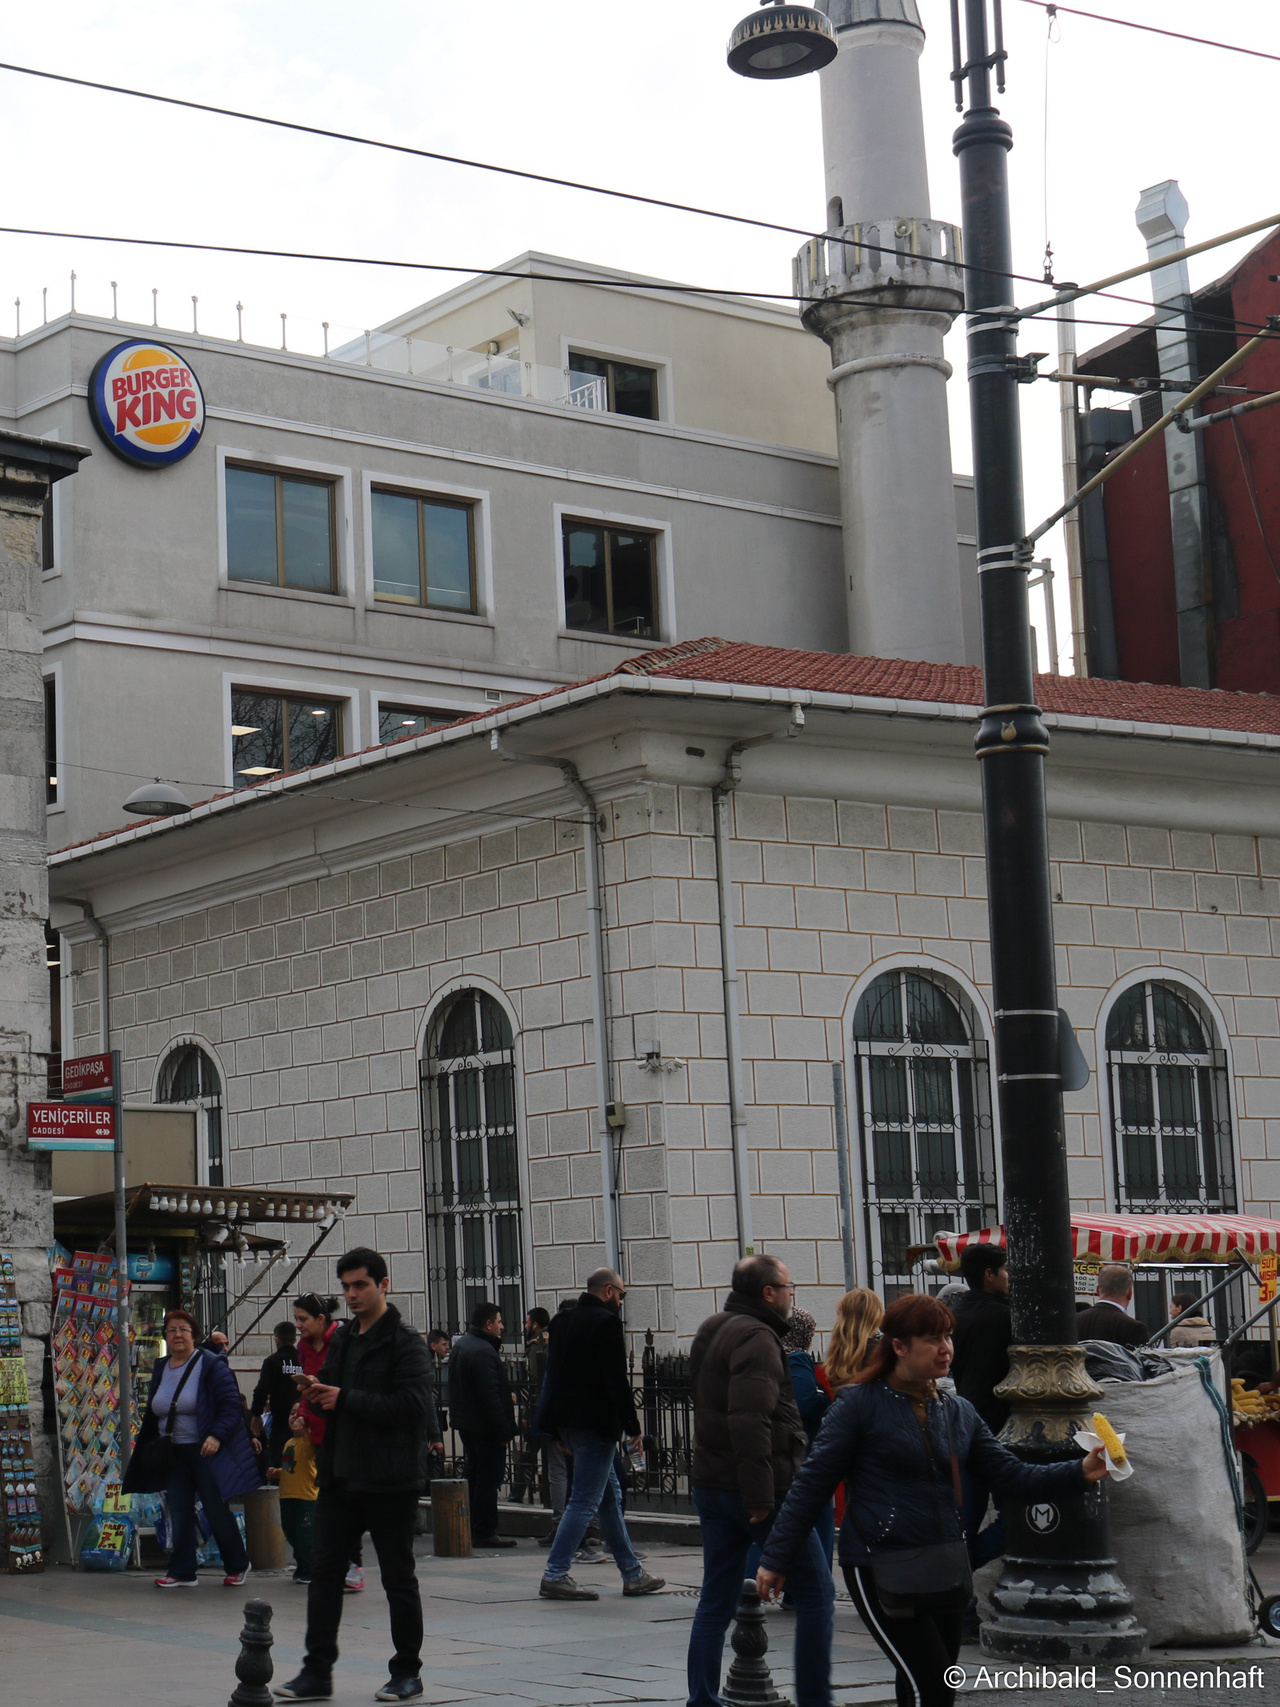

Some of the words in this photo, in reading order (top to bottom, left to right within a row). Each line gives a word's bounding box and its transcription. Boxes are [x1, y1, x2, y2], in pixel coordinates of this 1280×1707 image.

[112, 368, 192, 401] BURGER
[116, 389, 196, 433] KING
[65, 1060, 104, 1079] GEDİKPAŞA
[32, 1108, 111, 1125] YENİÇERİLER
[32, 1126, 64, 1135] CADDESİ
[1073, 1264, 1101, 1274] KEST
